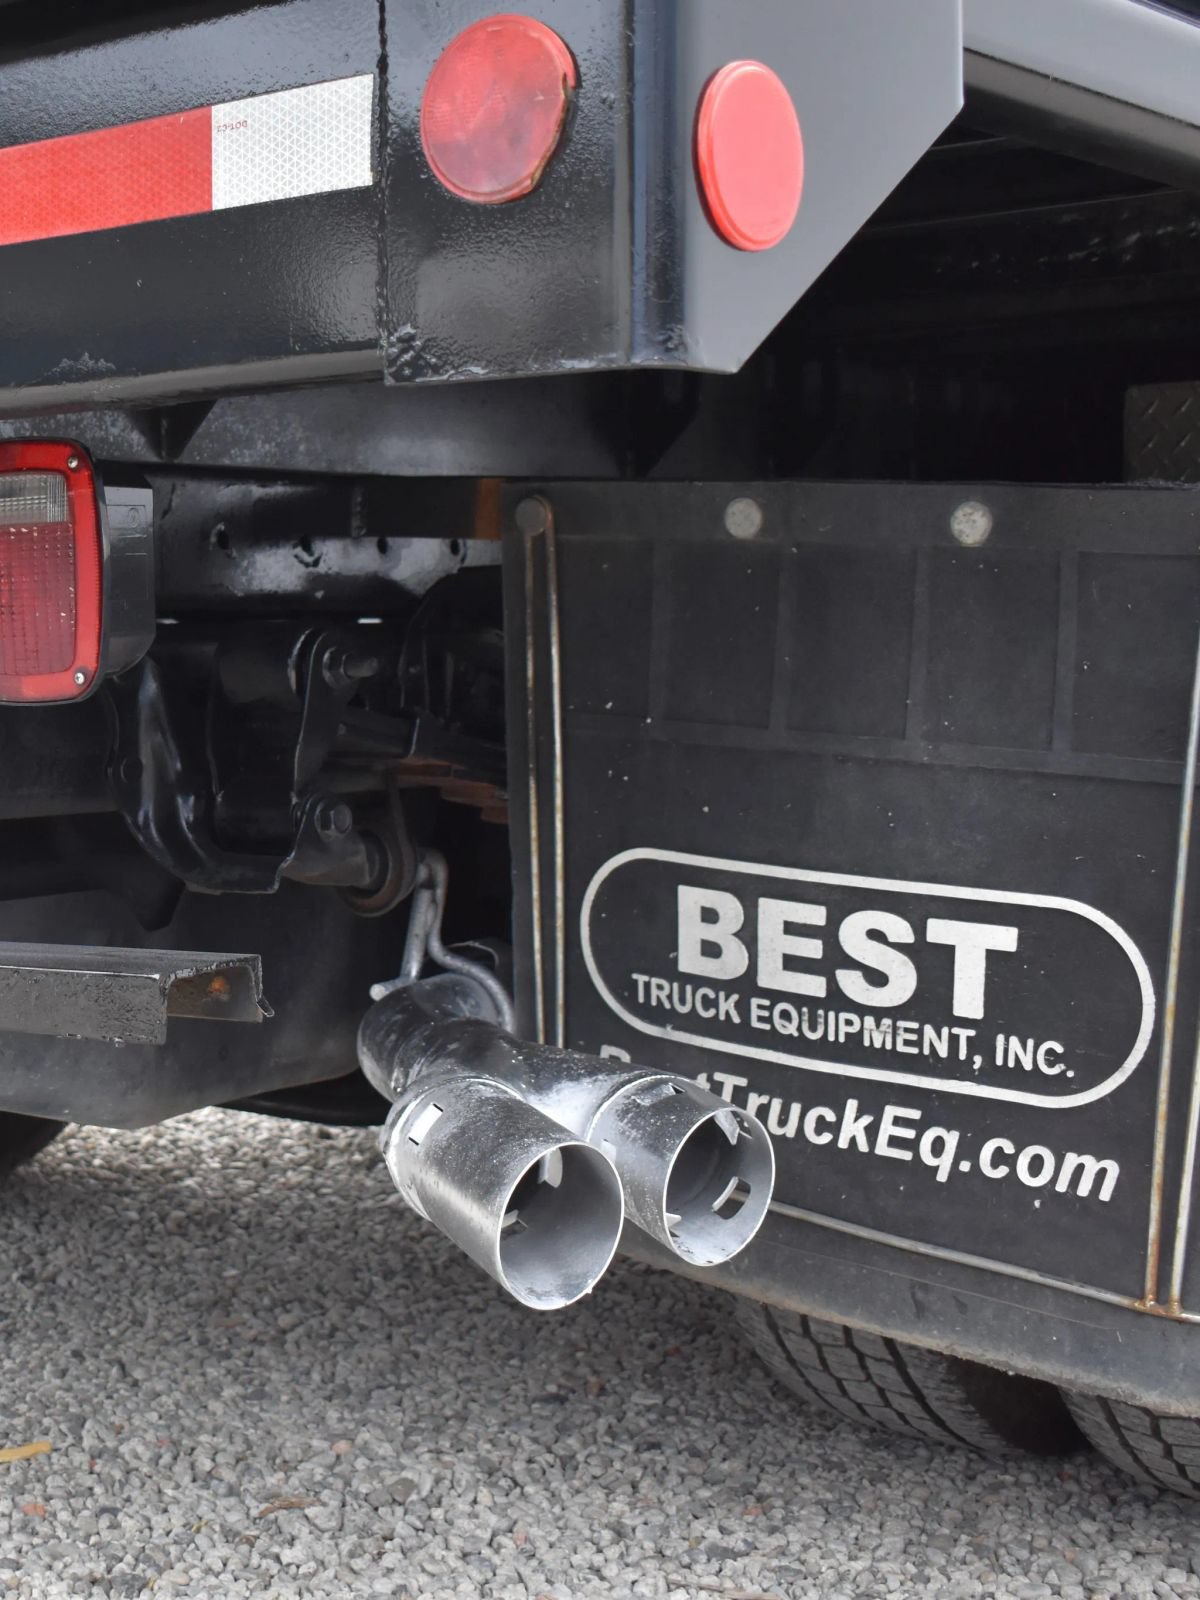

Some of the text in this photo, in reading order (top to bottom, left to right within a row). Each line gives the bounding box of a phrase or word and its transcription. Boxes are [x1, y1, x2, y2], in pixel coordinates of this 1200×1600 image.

[677, 884, 1018, 1020] BEST
[631, 972, 1075, 1078] TRUCK EQUIPMENT, INC.
[600, 1044, 1120, 1202] TruckEq.com
